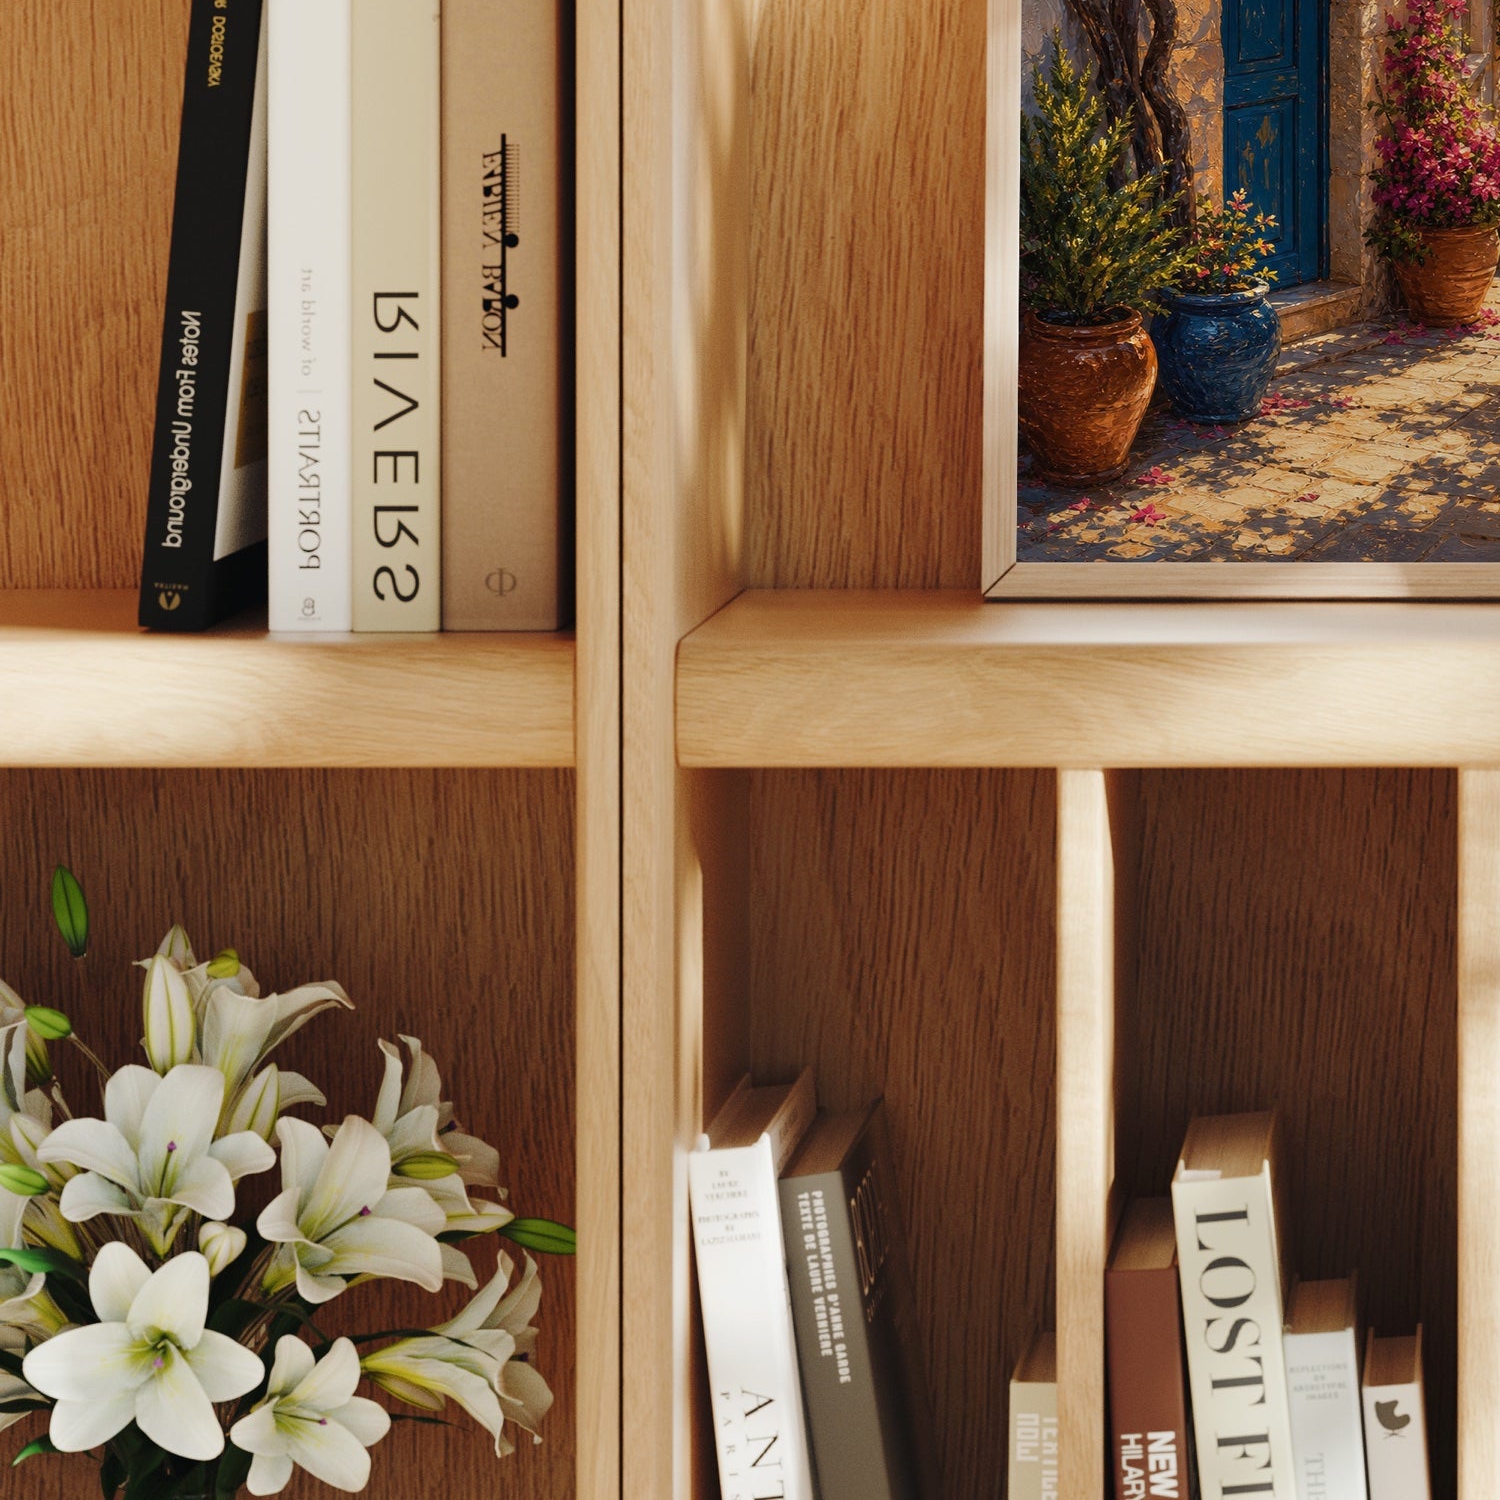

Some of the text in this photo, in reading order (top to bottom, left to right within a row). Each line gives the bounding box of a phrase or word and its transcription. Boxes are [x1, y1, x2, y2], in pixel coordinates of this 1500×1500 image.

[797, 1192, 814, 1230] TEXTE
[804, 1234, 817, 1250] DE
[807, 1254, 824, 1293] LAURE
[812, 1190, 851, 1384] PHOTOGRAPHIES D'ANNE GARDE
[1194, 1204, 1267, 1406] LOST
[1147, 1431, 1179, 1498] NEW
